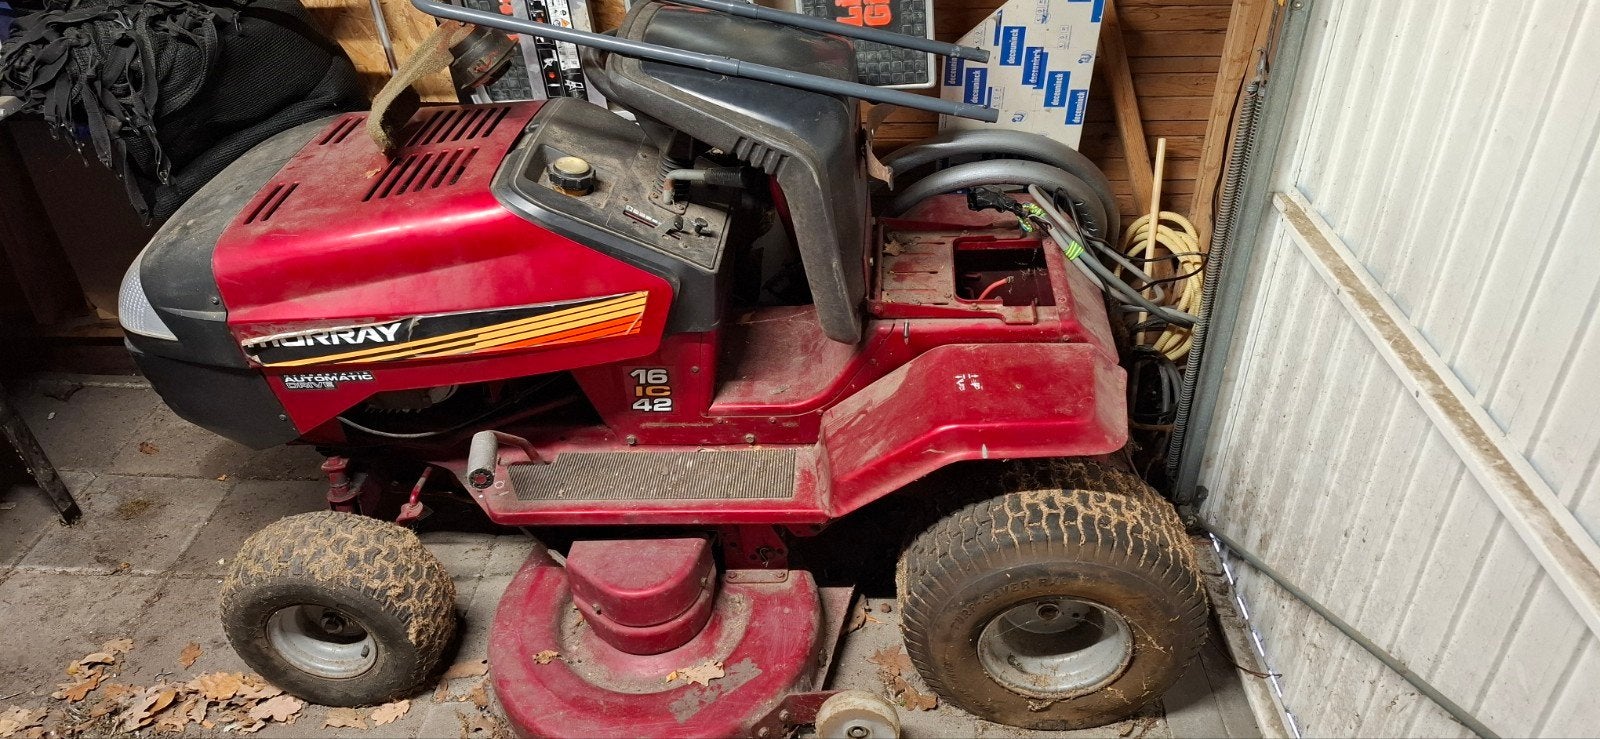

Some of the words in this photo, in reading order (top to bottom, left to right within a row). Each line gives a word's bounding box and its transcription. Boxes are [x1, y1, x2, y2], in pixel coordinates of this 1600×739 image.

[1006, 28, 1020, 65] deceuninck
[970, 69, 982, 104] deceuninck
[1050, 73, 1064, 106] deceuninck
[1072, 91, 1086, 124] deceuninck
[284, 373, 373, 383] AUTOMATIC
[285, 381, 335, 390] DRIVE
[630, 369, 668, 384] 16
[632, 398, 672, 412] 42
